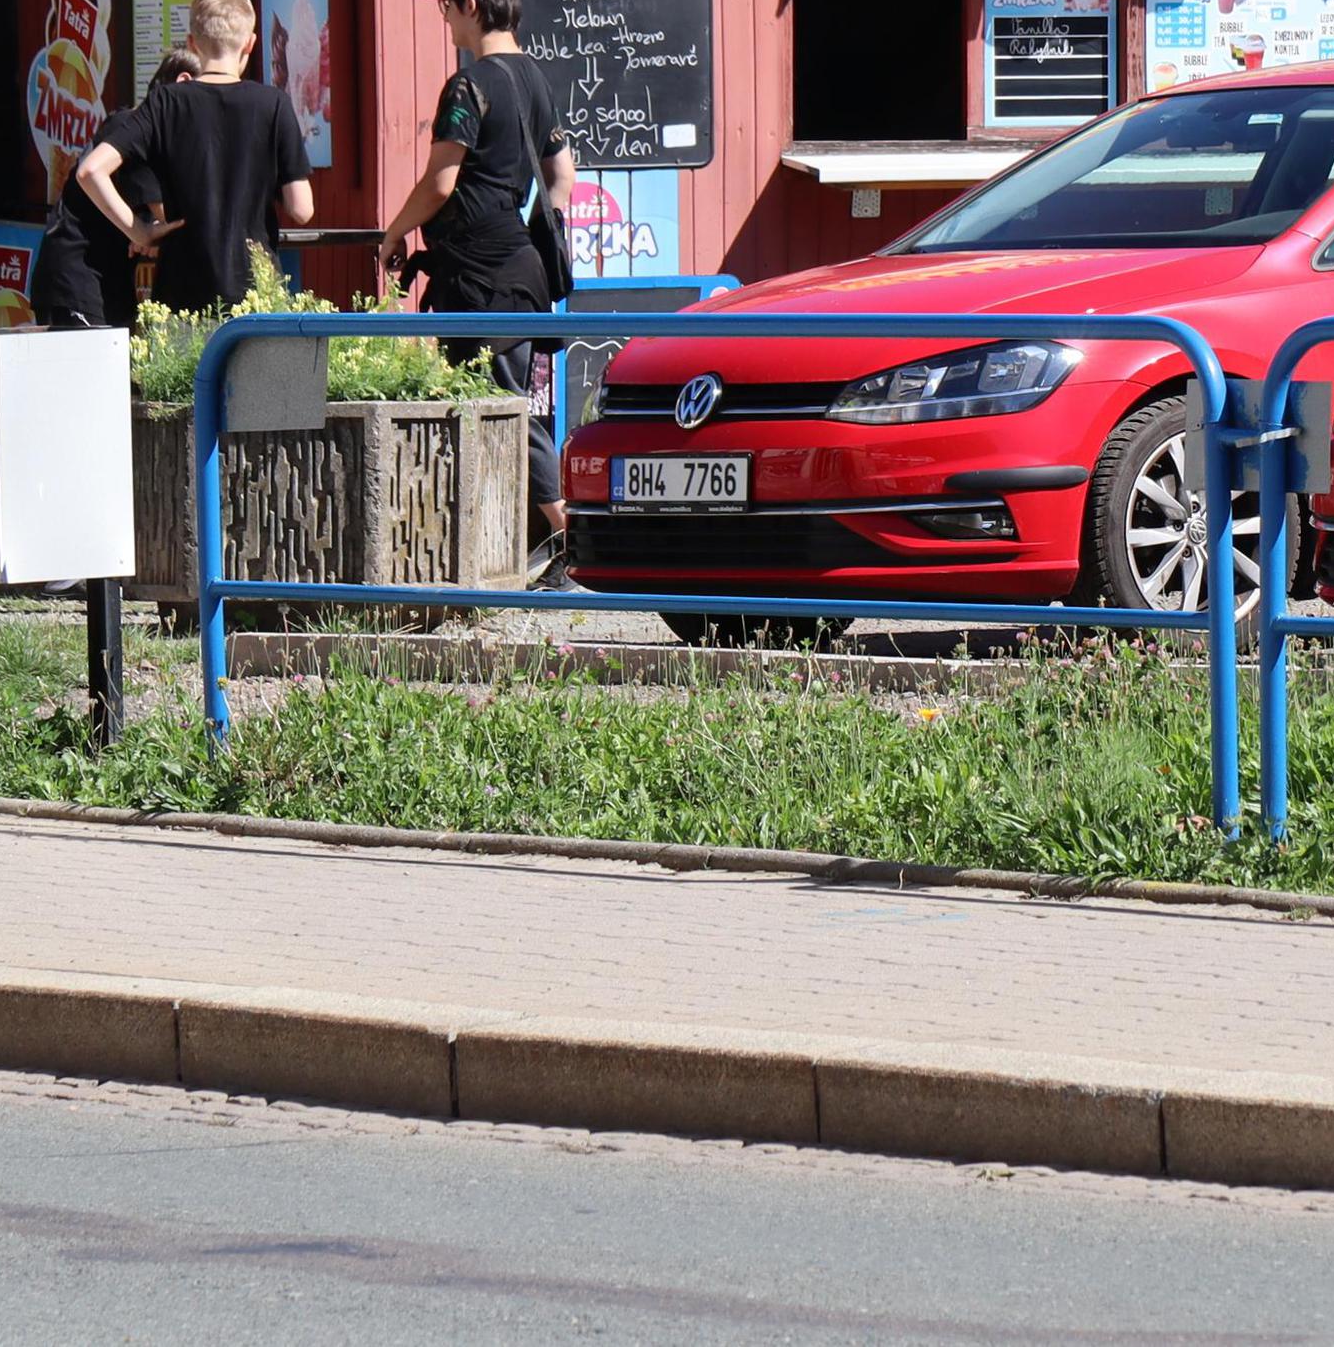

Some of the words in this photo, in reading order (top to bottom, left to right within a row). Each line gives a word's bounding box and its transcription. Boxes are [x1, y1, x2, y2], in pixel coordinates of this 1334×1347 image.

[64, 0, 91, 41] Tatra
[1219, 22, 1244, 32] BUBBLE
[524, 33, 574, 61] ubble
[1183, 55, 1208, 66] BUBBLE
[566, 81, 588, 125] to
[596, 85, 652, 123] school
[564, 201, 608, 219] atra
[567, 222, 658, 264] RZKA
[613, 486, 624, 497] CZ
[628, 462, 666, 497] 8H4
[683, 462, 737, 497] 7766
